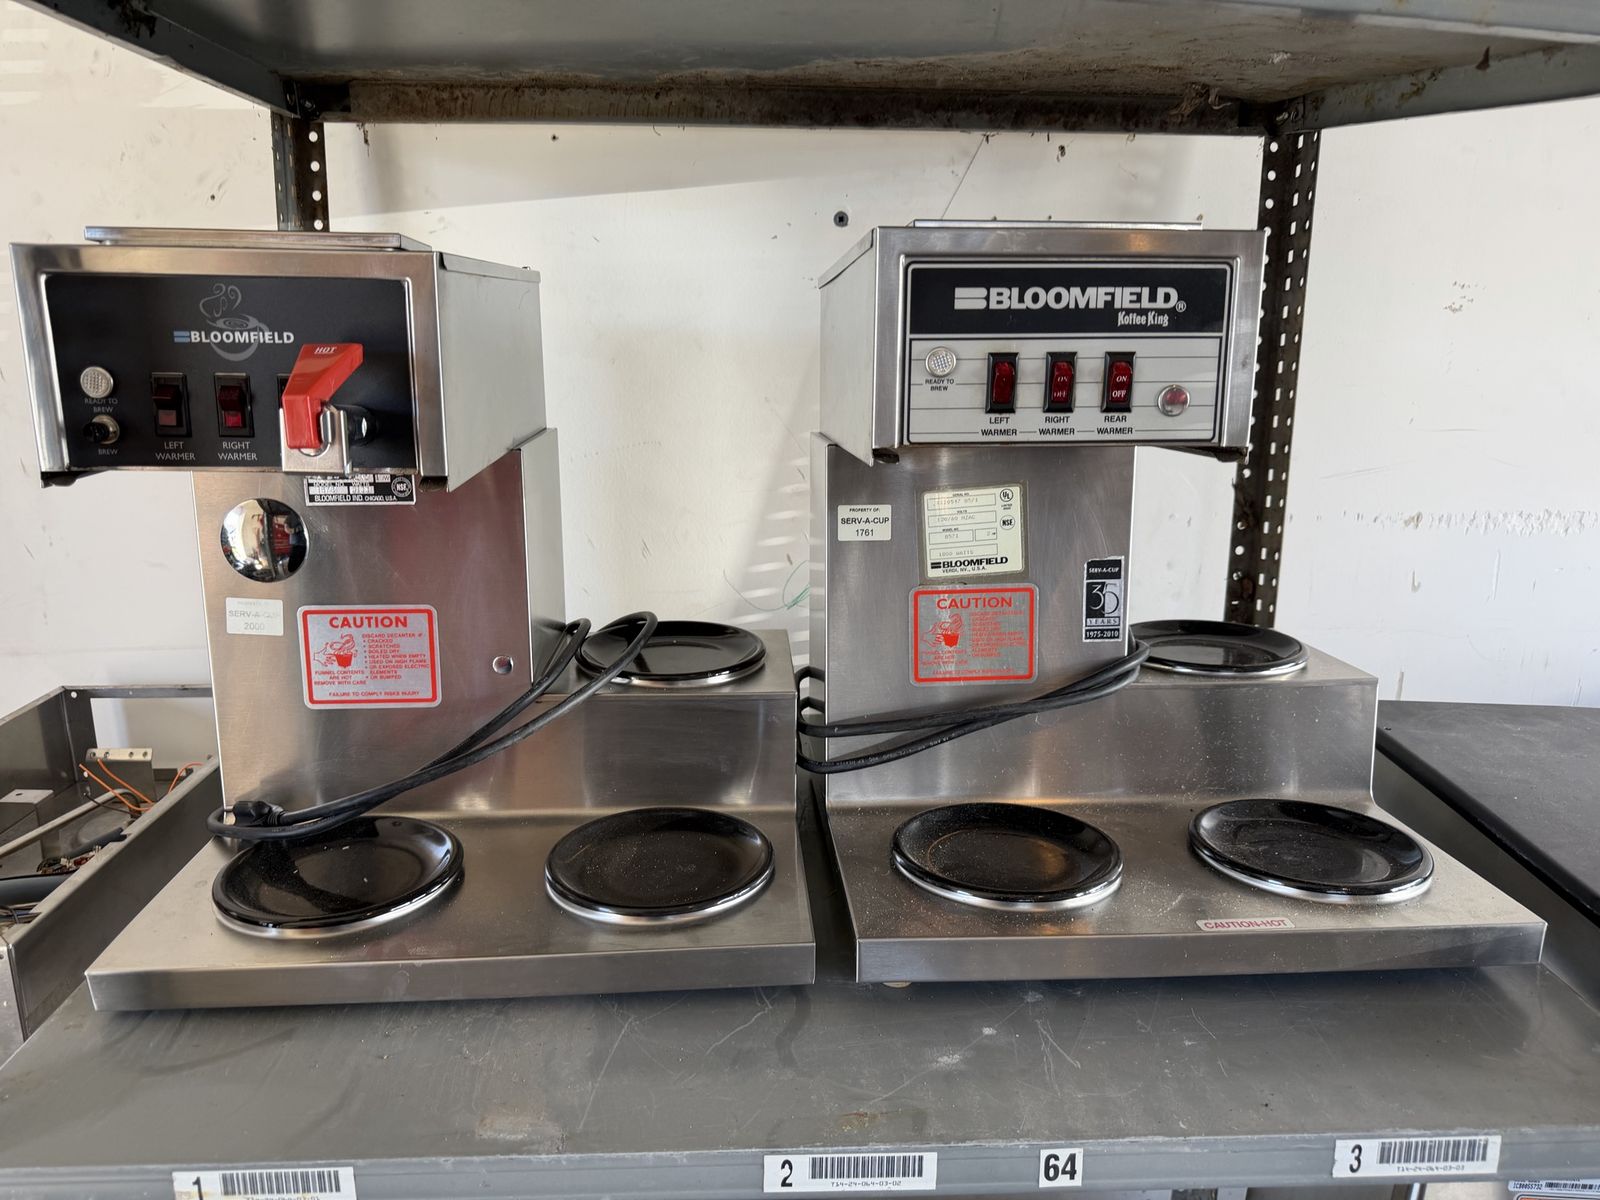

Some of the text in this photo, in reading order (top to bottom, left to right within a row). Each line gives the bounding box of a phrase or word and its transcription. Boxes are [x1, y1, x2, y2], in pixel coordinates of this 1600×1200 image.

[989, 286, 1178, 310] BLOOMFIELD
[1117, 311, 1169, 327] Koffee King
[191, 331, 295, 344] BLOOMFIELD
[314, 346, 337, 354] HOT
[1112, 390, 1126, 398] OFF
[1044, 416, 1070, 424] RIGHT
[1104, 415, 1127, 423] REAR
[1097, 427, 1133, 435] WARMER
[164, 441, 184, 450] LEFT
[222, 441, 251, 450] RIGHT
[155, 452, 196, 461] WARMER
[217, 452, 258, 461] WARMER
[840, 517, 889, 525] SERV-A-CUP
[856, 528, 874, 537] 1761
[942, 557, 1008, 568] BLOOMFIELD
[937, 597, 1012, 609] CAUTION
[1089, 583, 1120, 614] 35
[329, 616, 408, 628] CAUTION
[1086, 630, 1119, 638] 1975-2010
[1203, 919, 1288, 929] CAUTION-HOT
[1349, 1144, 1363, 1173] 3
[1044, 1153, 1077, 1181] 64
[780, 1159, 793, 1188] 2
[192, 1176, 204, 1200] 1
